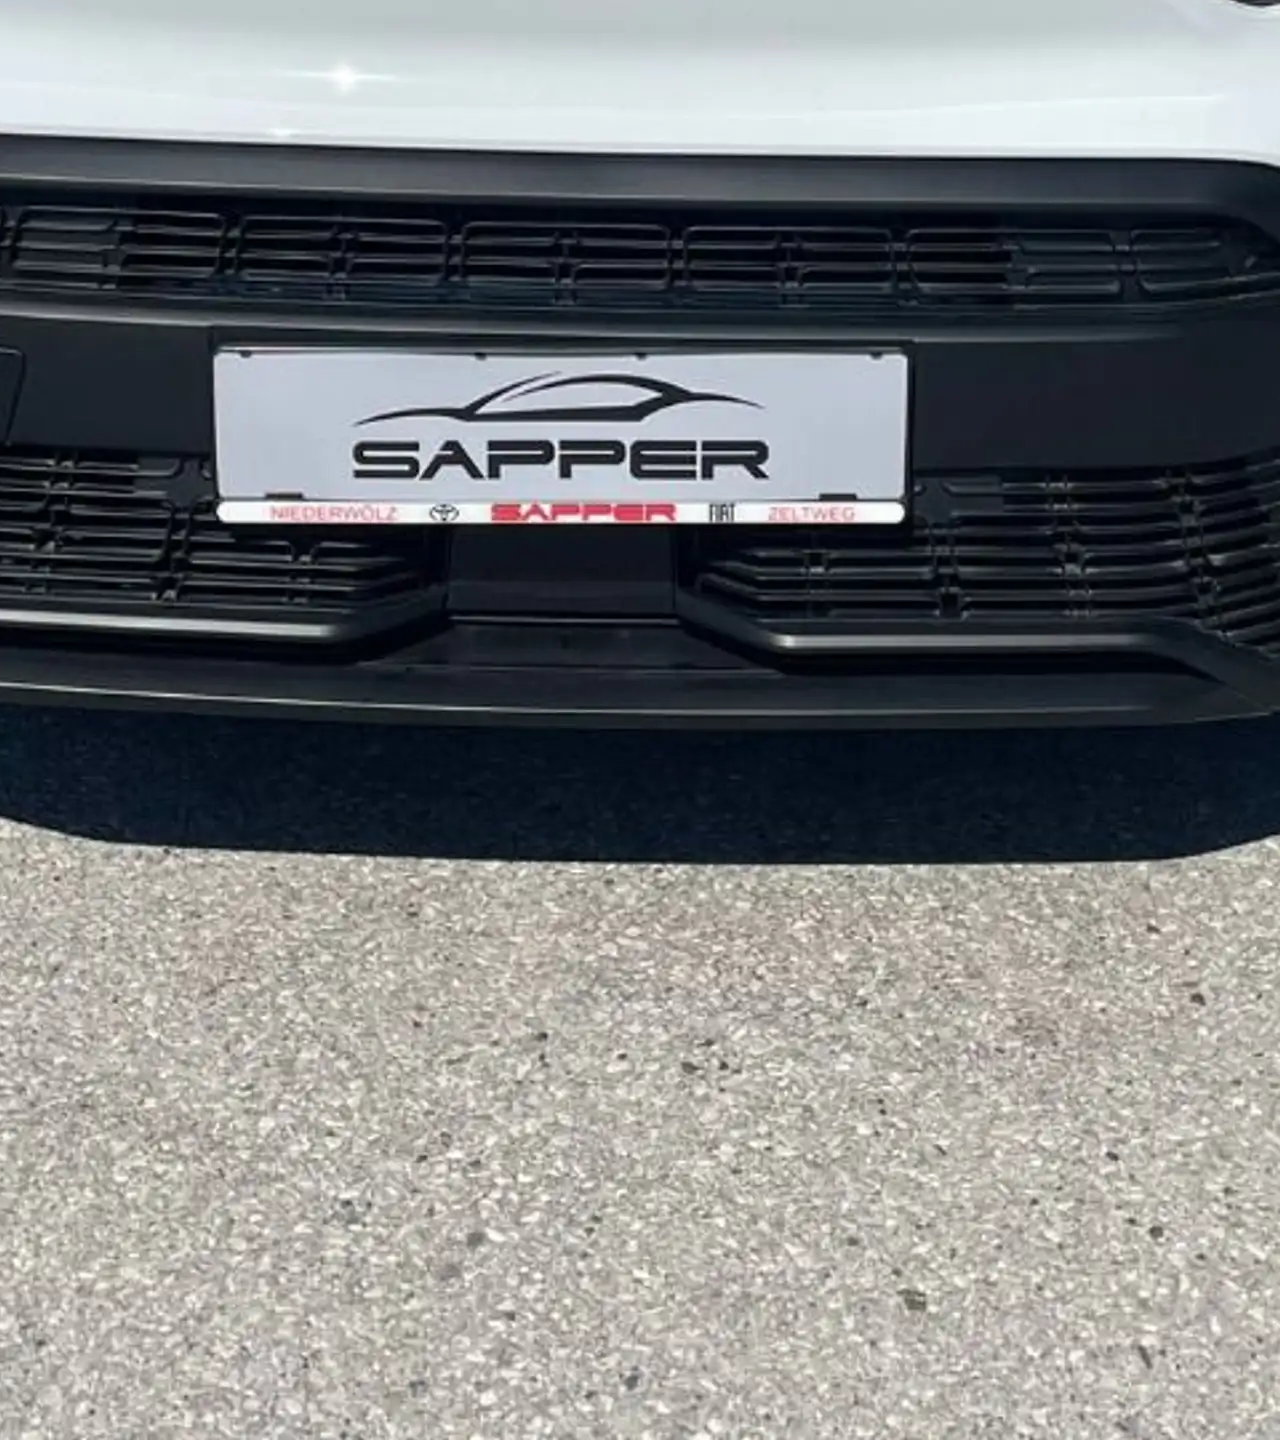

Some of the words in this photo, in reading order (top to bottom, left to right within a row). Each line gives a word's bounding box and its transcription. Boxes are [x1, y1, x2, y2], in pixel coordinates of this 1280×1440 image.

[353, 440, 769, 480] SAPPER
[270, 503, 398, 521] NIEDERWÖLZ
[491, 503, 676, 522] SAPPER
[708, 503, 736, 523] FIAT
[768, 506, 856, 521] ZELTWEG
